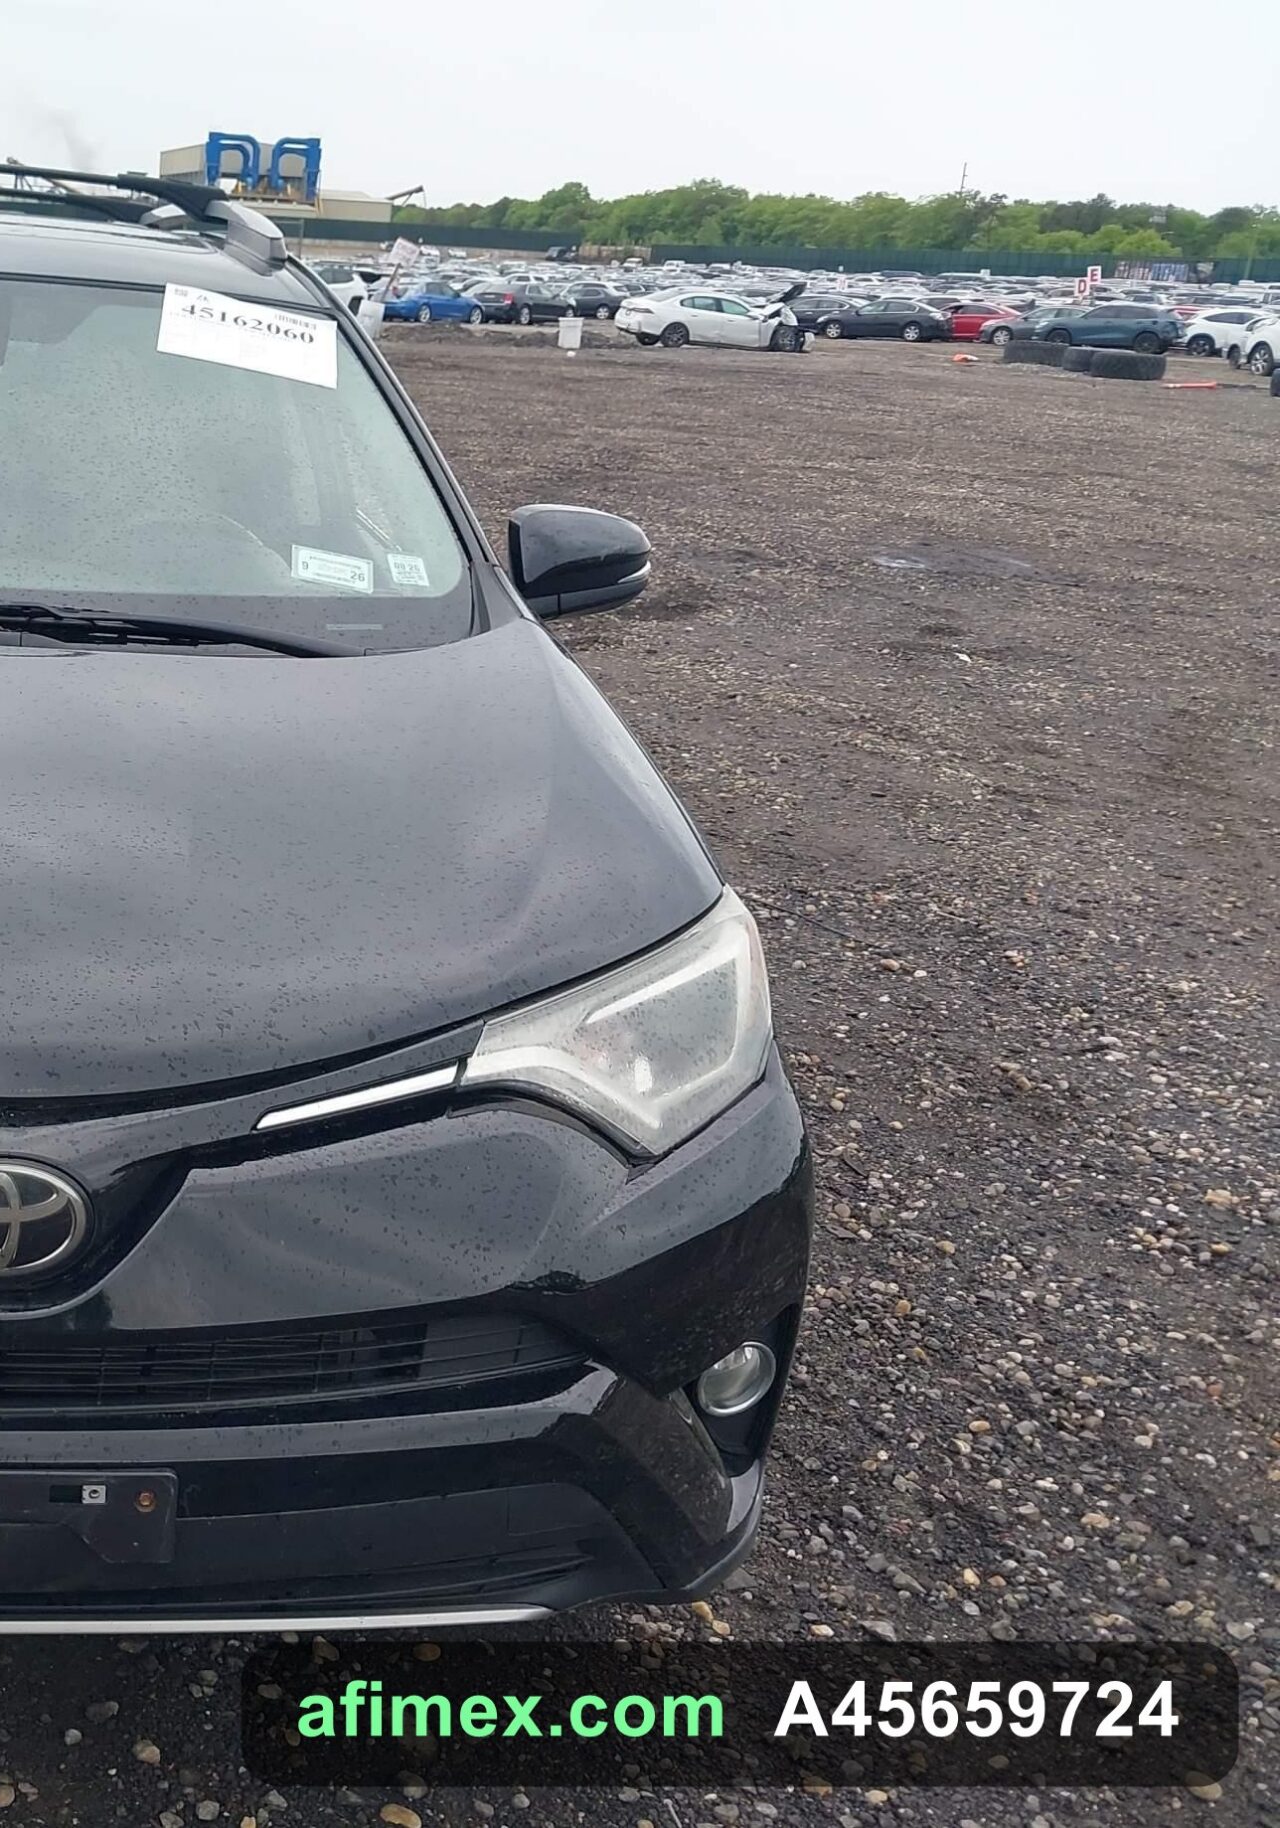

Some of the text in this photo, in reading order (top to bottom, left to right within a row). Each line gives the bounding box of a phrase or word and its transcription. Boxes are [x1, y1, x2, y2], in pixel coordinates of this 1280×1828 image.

[1090, 268, 1099, 282] E
[1078, 279, 1087, 294] D
[181, 304, 315, 344] 45162060
[301, 561, 309, 571] 9
[349, 570, 366, 582] 26
